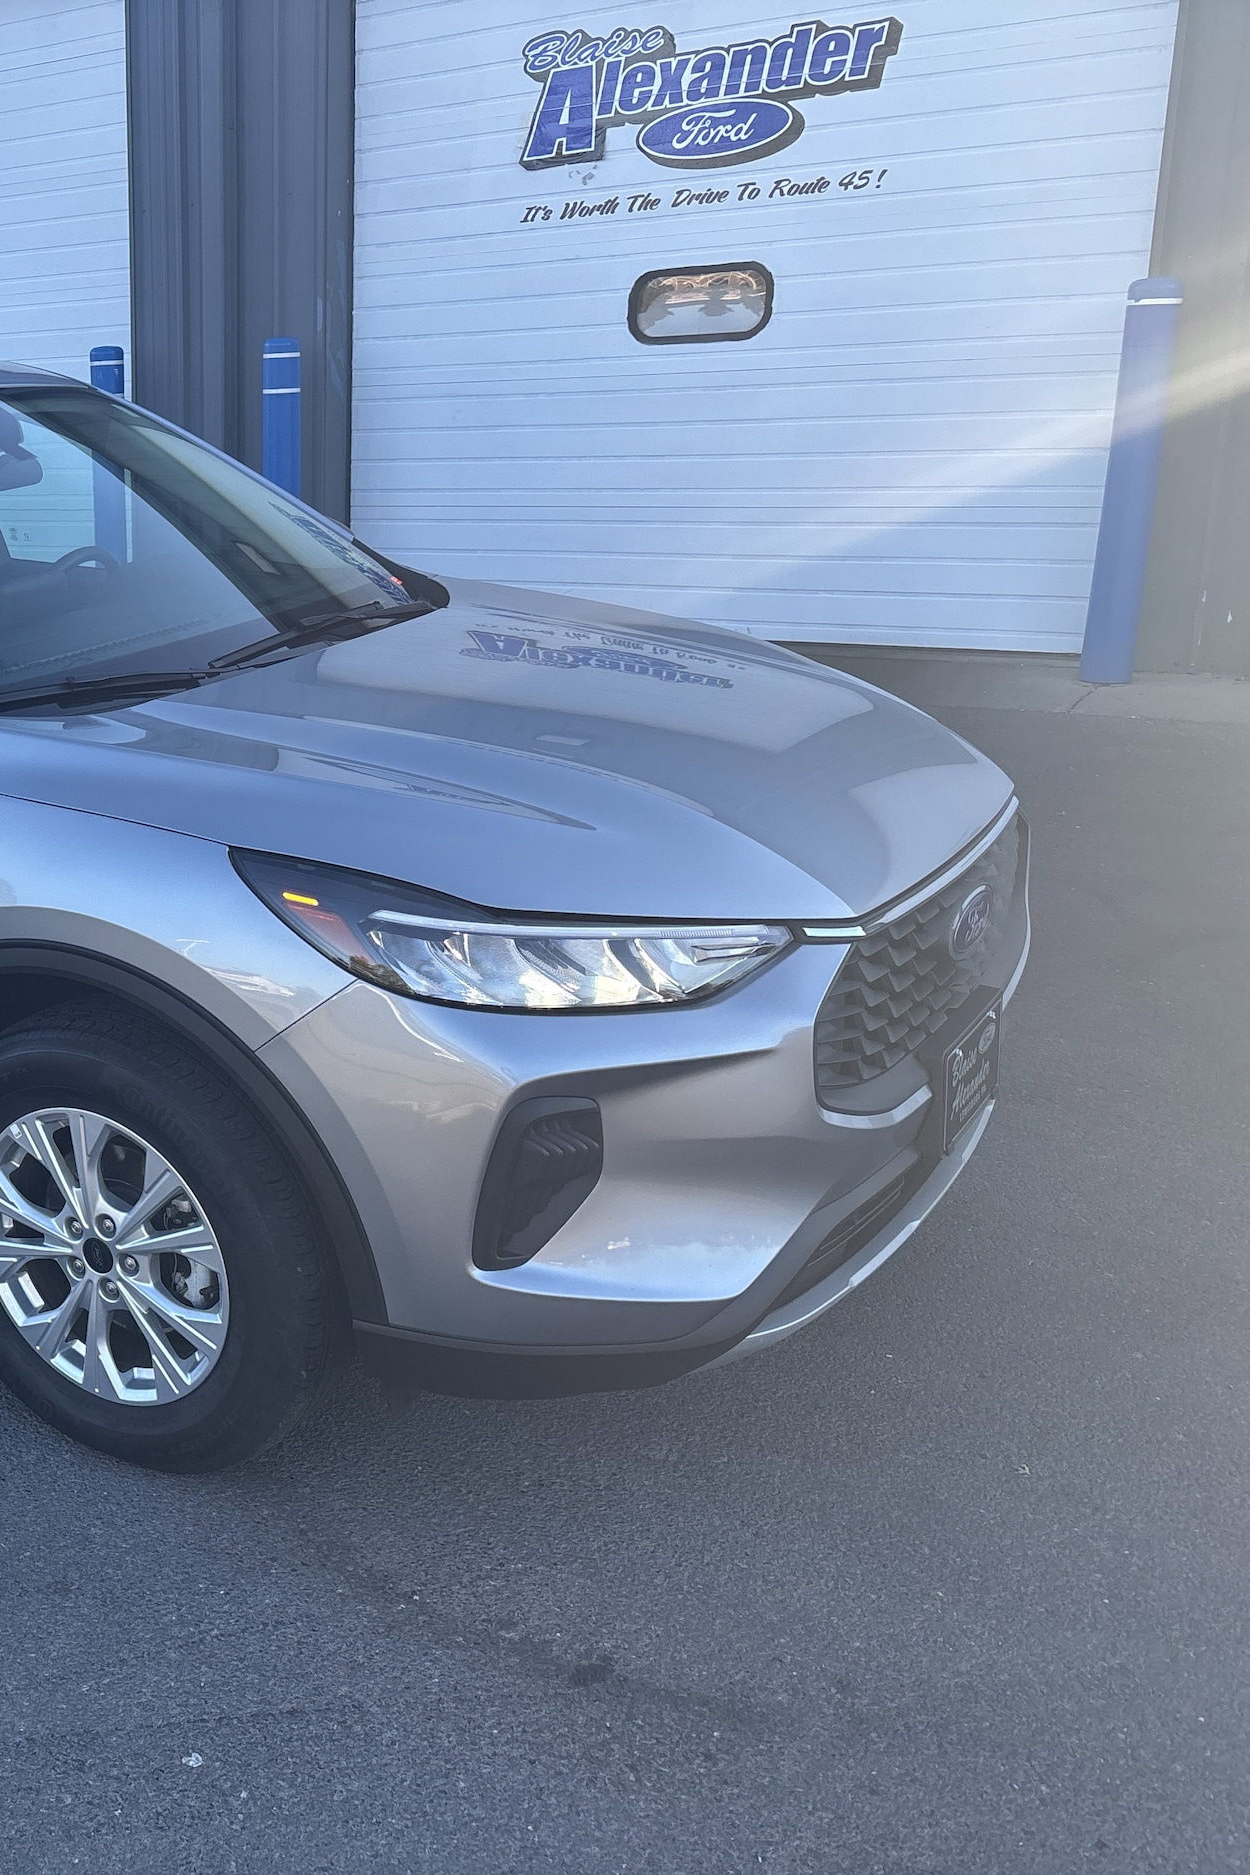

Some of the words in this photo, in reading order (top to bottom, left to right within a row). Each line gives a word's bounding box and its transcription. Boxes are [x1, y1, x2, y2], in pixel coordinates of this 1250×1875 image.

[524, 27, 666, 73] Blaise
[522, 18, 898, 162] Alexander
[671, 108, 755, 150] Ford
[519, 203, 554, 225] It's
[559, 194, 620, 221] Worth
[626, 192, 662, 213] The
[670, 187, 729, 209] Drive
[736, 180, 762, 201] To
[767, 175, 831, 199] Route
